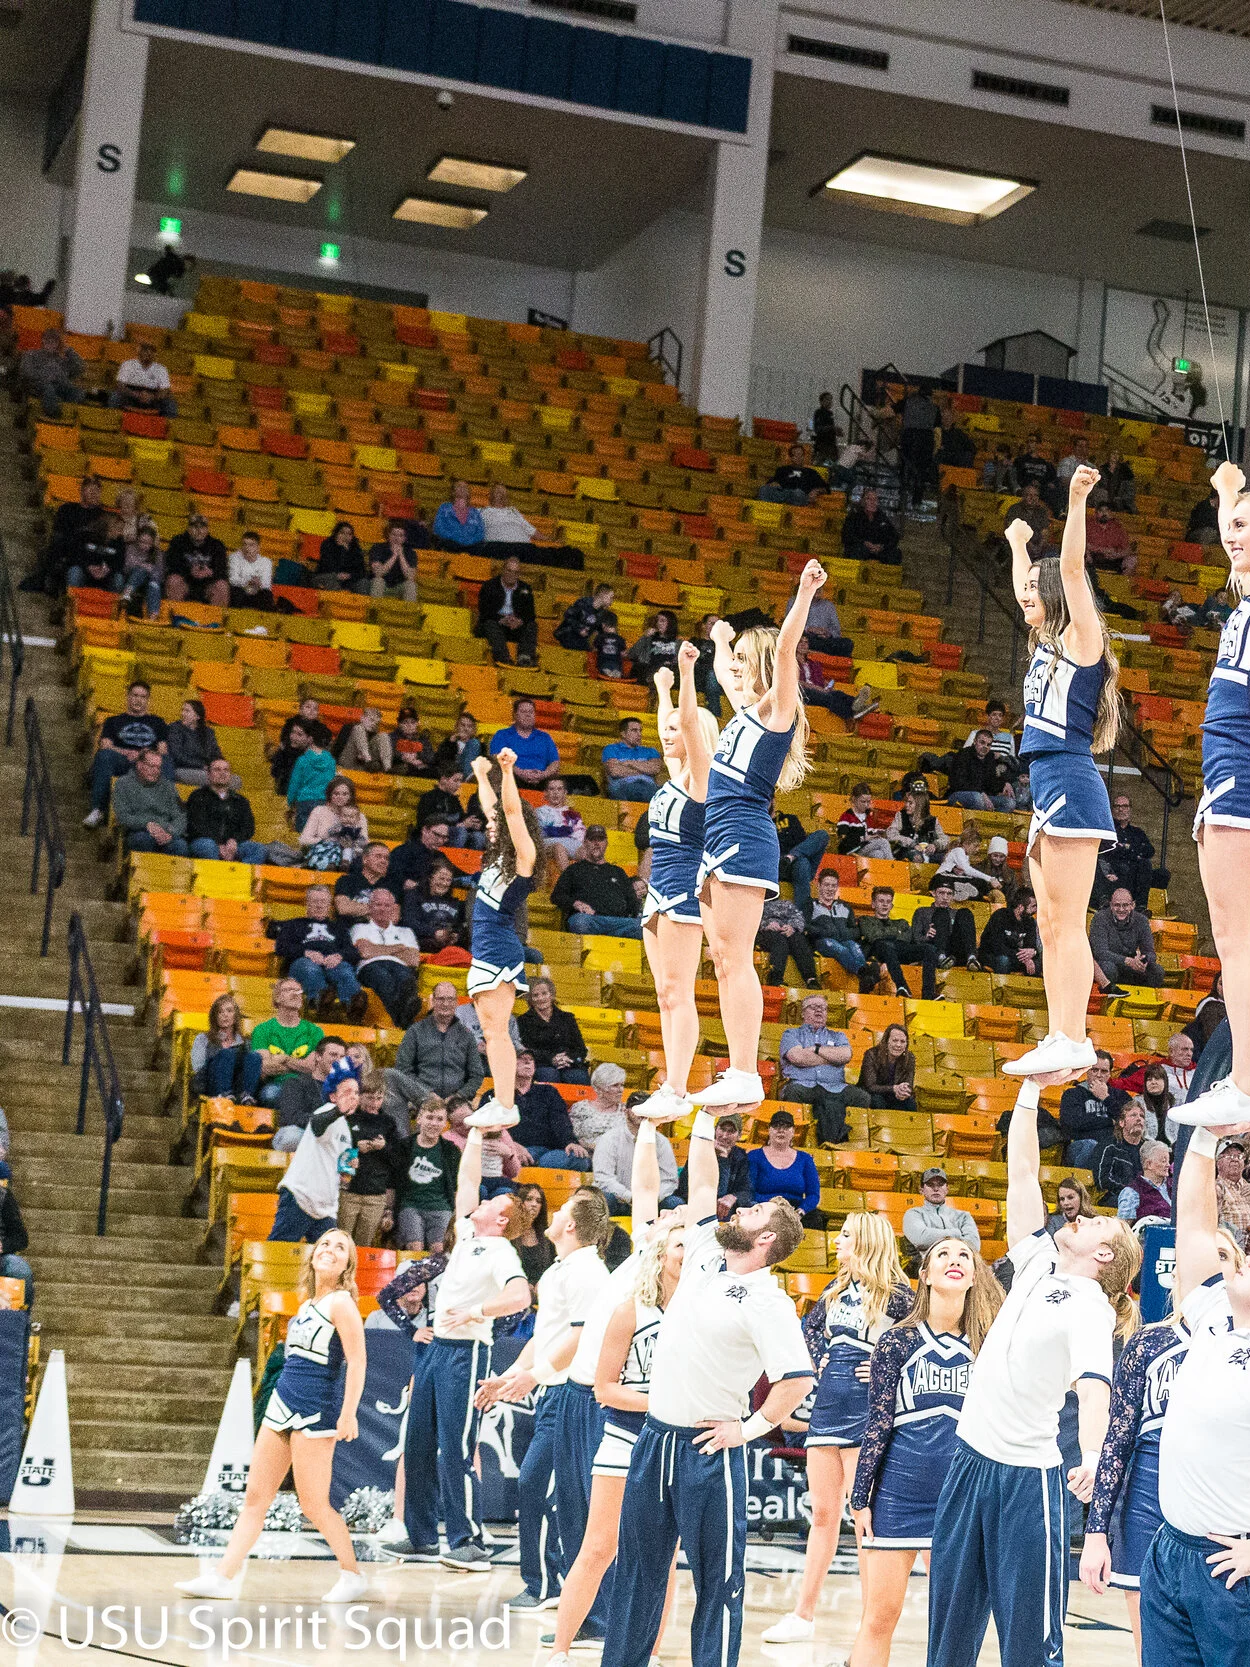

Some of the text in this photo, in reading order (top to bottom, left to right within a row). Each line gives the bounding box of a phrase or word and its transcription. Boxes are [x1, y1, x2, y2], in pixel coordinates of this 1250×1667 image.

[97, 143, 121, 172] S
[724, 250, 746, 277] S
[914, 1357, 973, 1396] AGGIE
[20, 1465, 57, 1478] STATE
[217, 1472, 248, 1483] STAT
